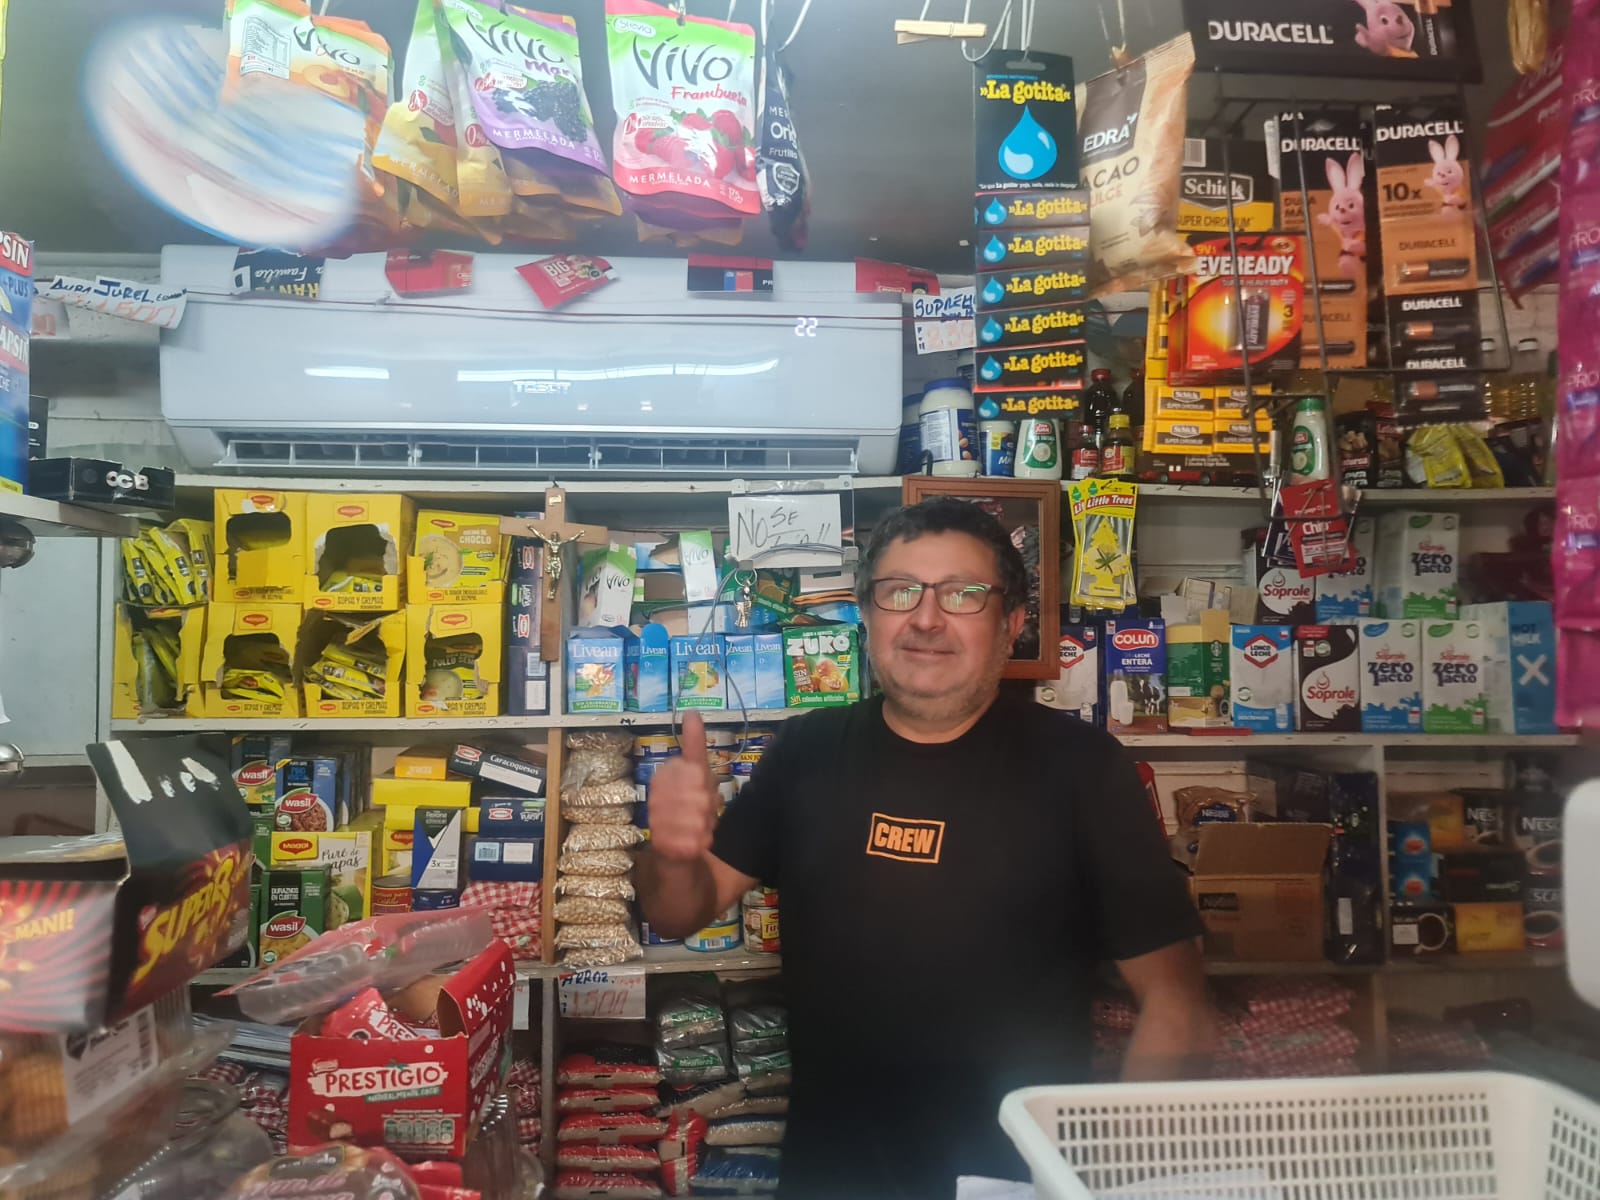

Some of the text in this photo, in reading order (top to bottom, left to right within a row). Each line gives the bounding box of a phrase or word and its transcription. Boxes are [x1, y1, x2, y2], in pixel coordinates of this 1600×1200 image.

[1208, 21, 1333, 45] DURACELL
[1376, 120, 1464, 142] DURACELL
[492, 128, 577, 150] MERMELADA
[1281, 136, 1361, 153] DURACELL
[628, 170, 711, 188] MERMELADA
[543, 260, 571, 285] BIG
[1196, 255, 1294, 276] EVEREADY
[1402, 296, 1462, 312] DURACELL
[794, 317, 818, 337] 22
[1111, 495, 1133, 506] Trees
[459, 535, 492, 545] CHOCLO
[1411, 553, 1452, 566] zero
[1414, 562, 1451, 576] lacto
[1263, 583, 1311, 600] Soprole
[786, 634, 850, 656] ZUKO
[1113, 633, 1156, 645] COLUN
[641, 645, 667, 655] Livean
[676, 642, 721, 657] Livean
[1121, 658, 1153, 666] ENTERA
[1367, 661, 1414, 675] zero
[1432, 661, 1478, 675] zero
[1373, 672, 1413, 686] lacto
[1437, 672, 1477, 687] lacto
[1306, 684, 1355, 702] Soprole
[489, 754, 540, 776] Caracoquesos
[241, 769, 268, 780] wasil
[285, 797, 311, 808] wasil
[873, 822, 936, 854] CREW
[271, 887, 300, 895] DURAZNOS
[270, 921, 299, 932] wasil
[325, 1065, 441, 1094] PRESTIGIO
